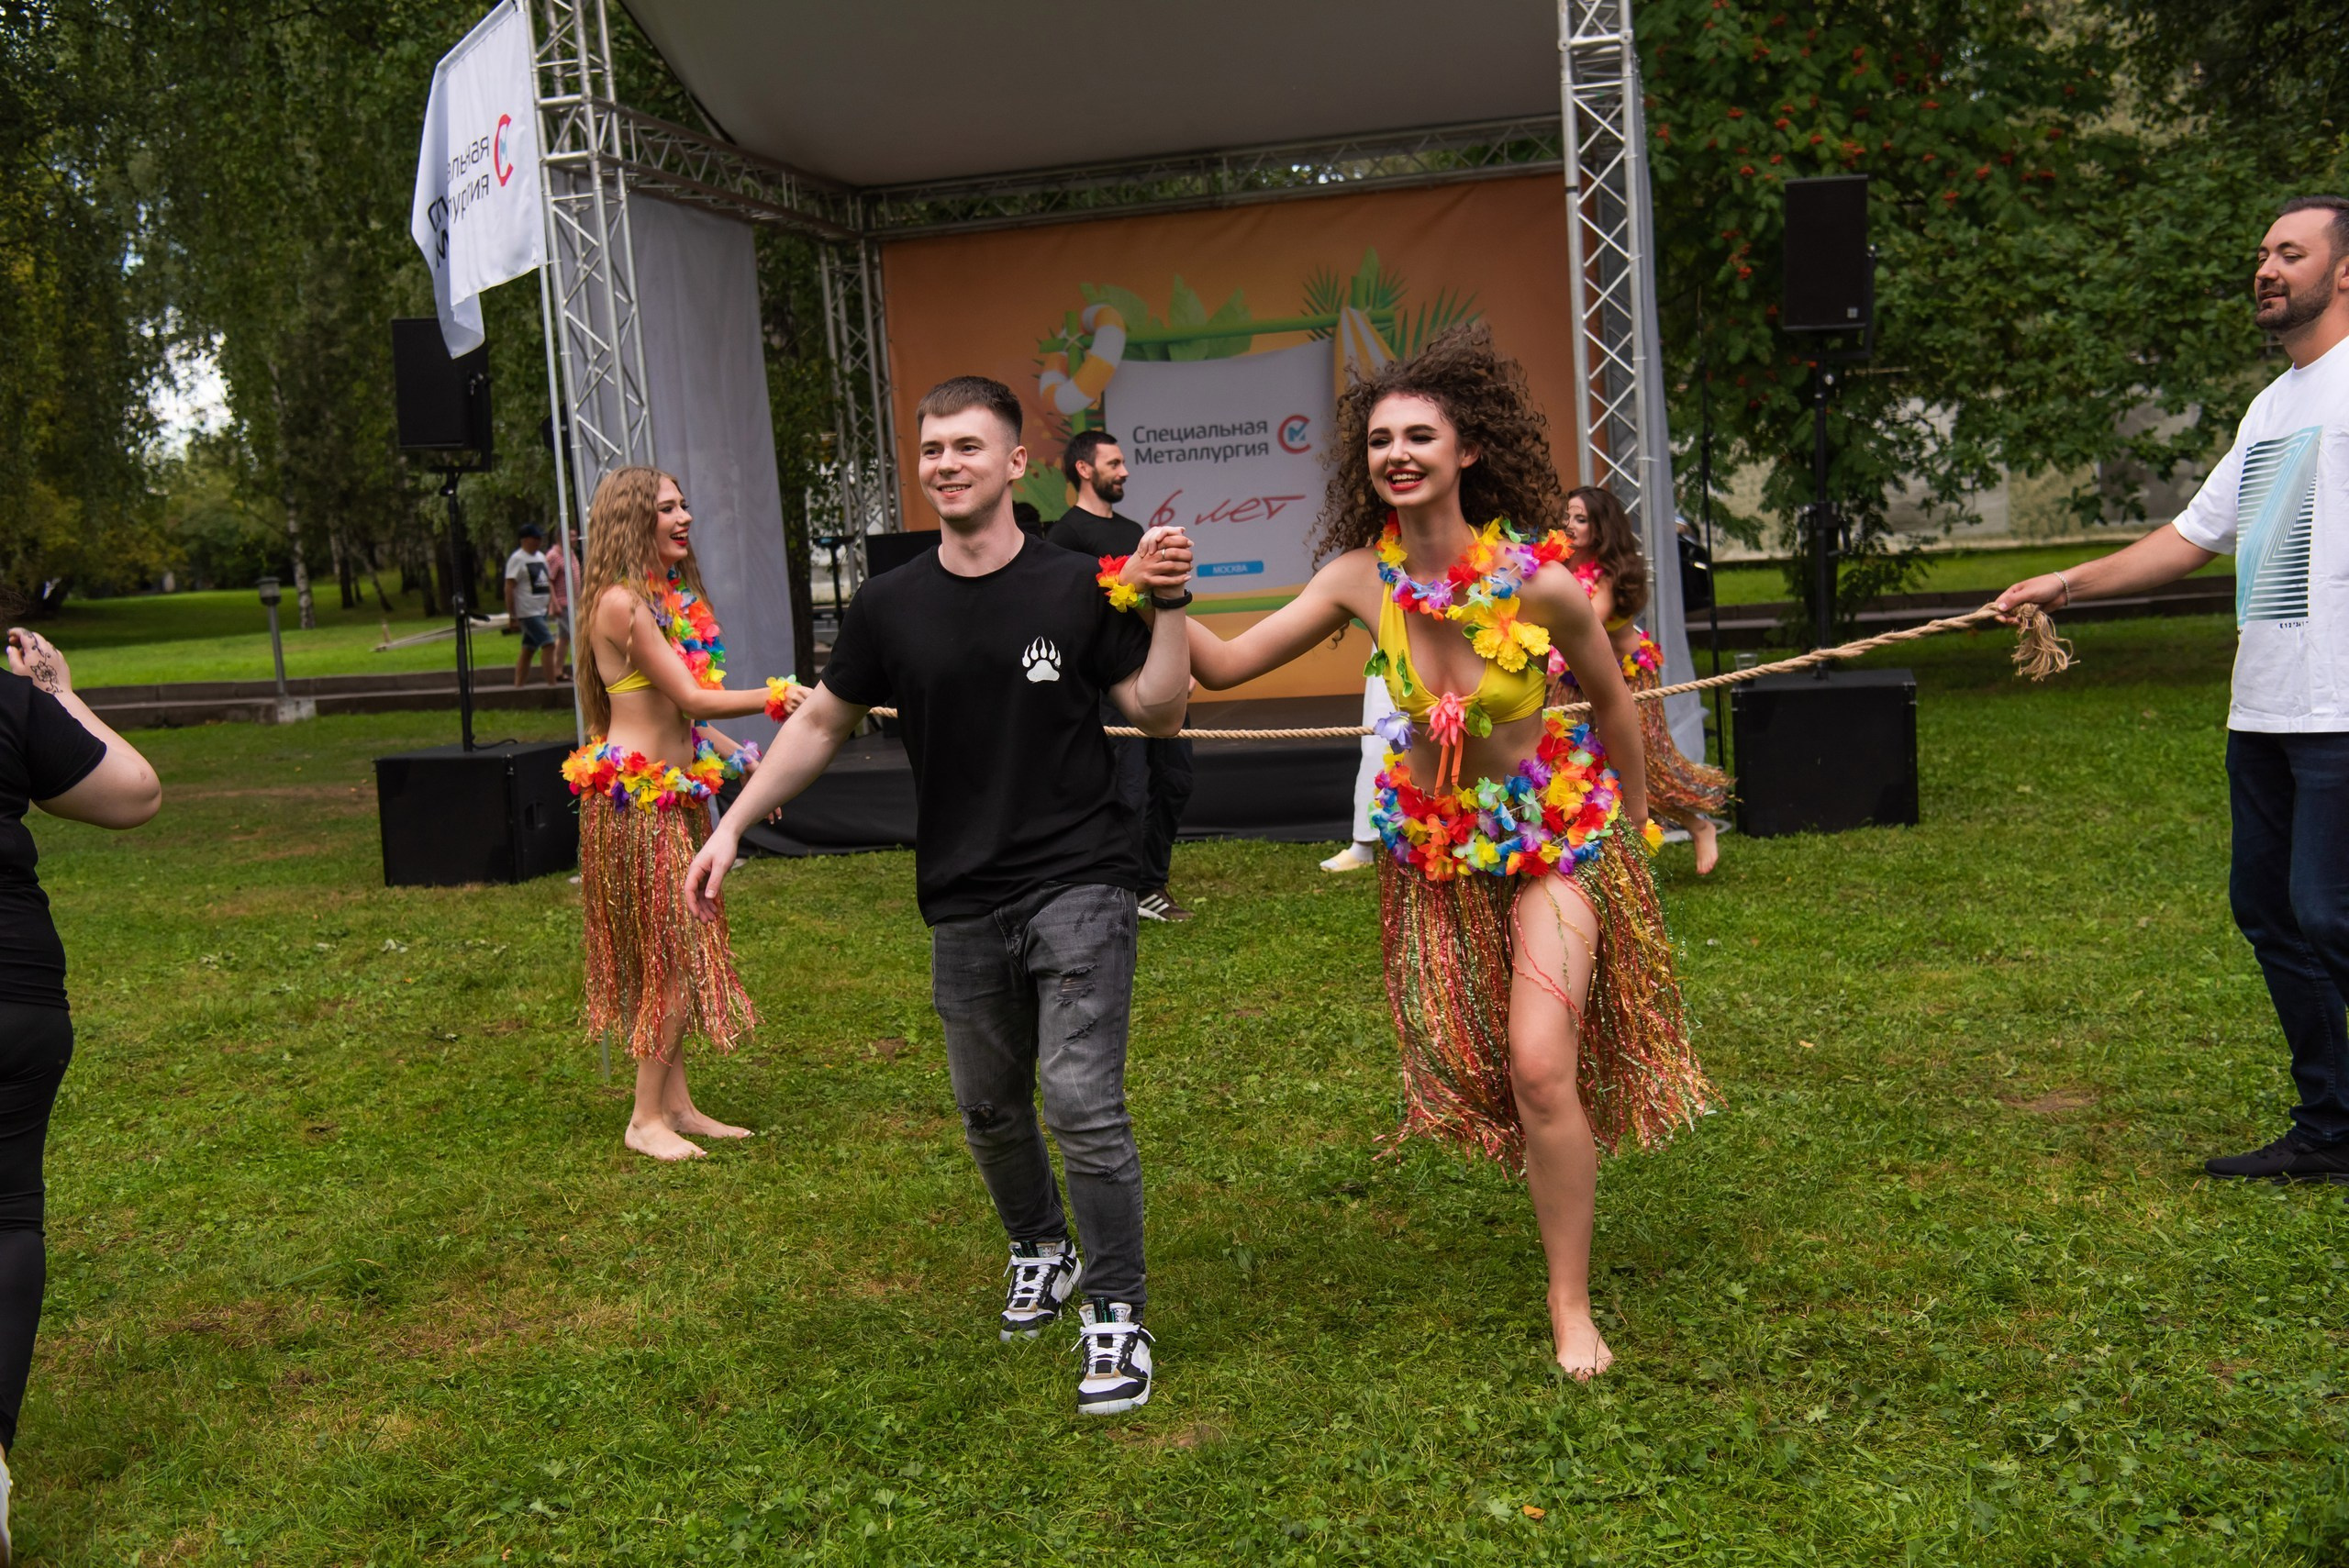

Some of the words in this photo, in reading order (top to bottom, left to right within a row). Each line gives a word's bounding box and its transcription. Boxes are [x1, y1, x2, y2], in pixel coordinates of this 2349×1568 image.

[1132, 420, 1268, 444] Специальная
[1134, 442, 1269, 465] Металлургия
[1149, 489, 1183, 528] 6
[1195, 494, 1307, 526] лет
[1212, 564, 1248, 574] МОСКВА
